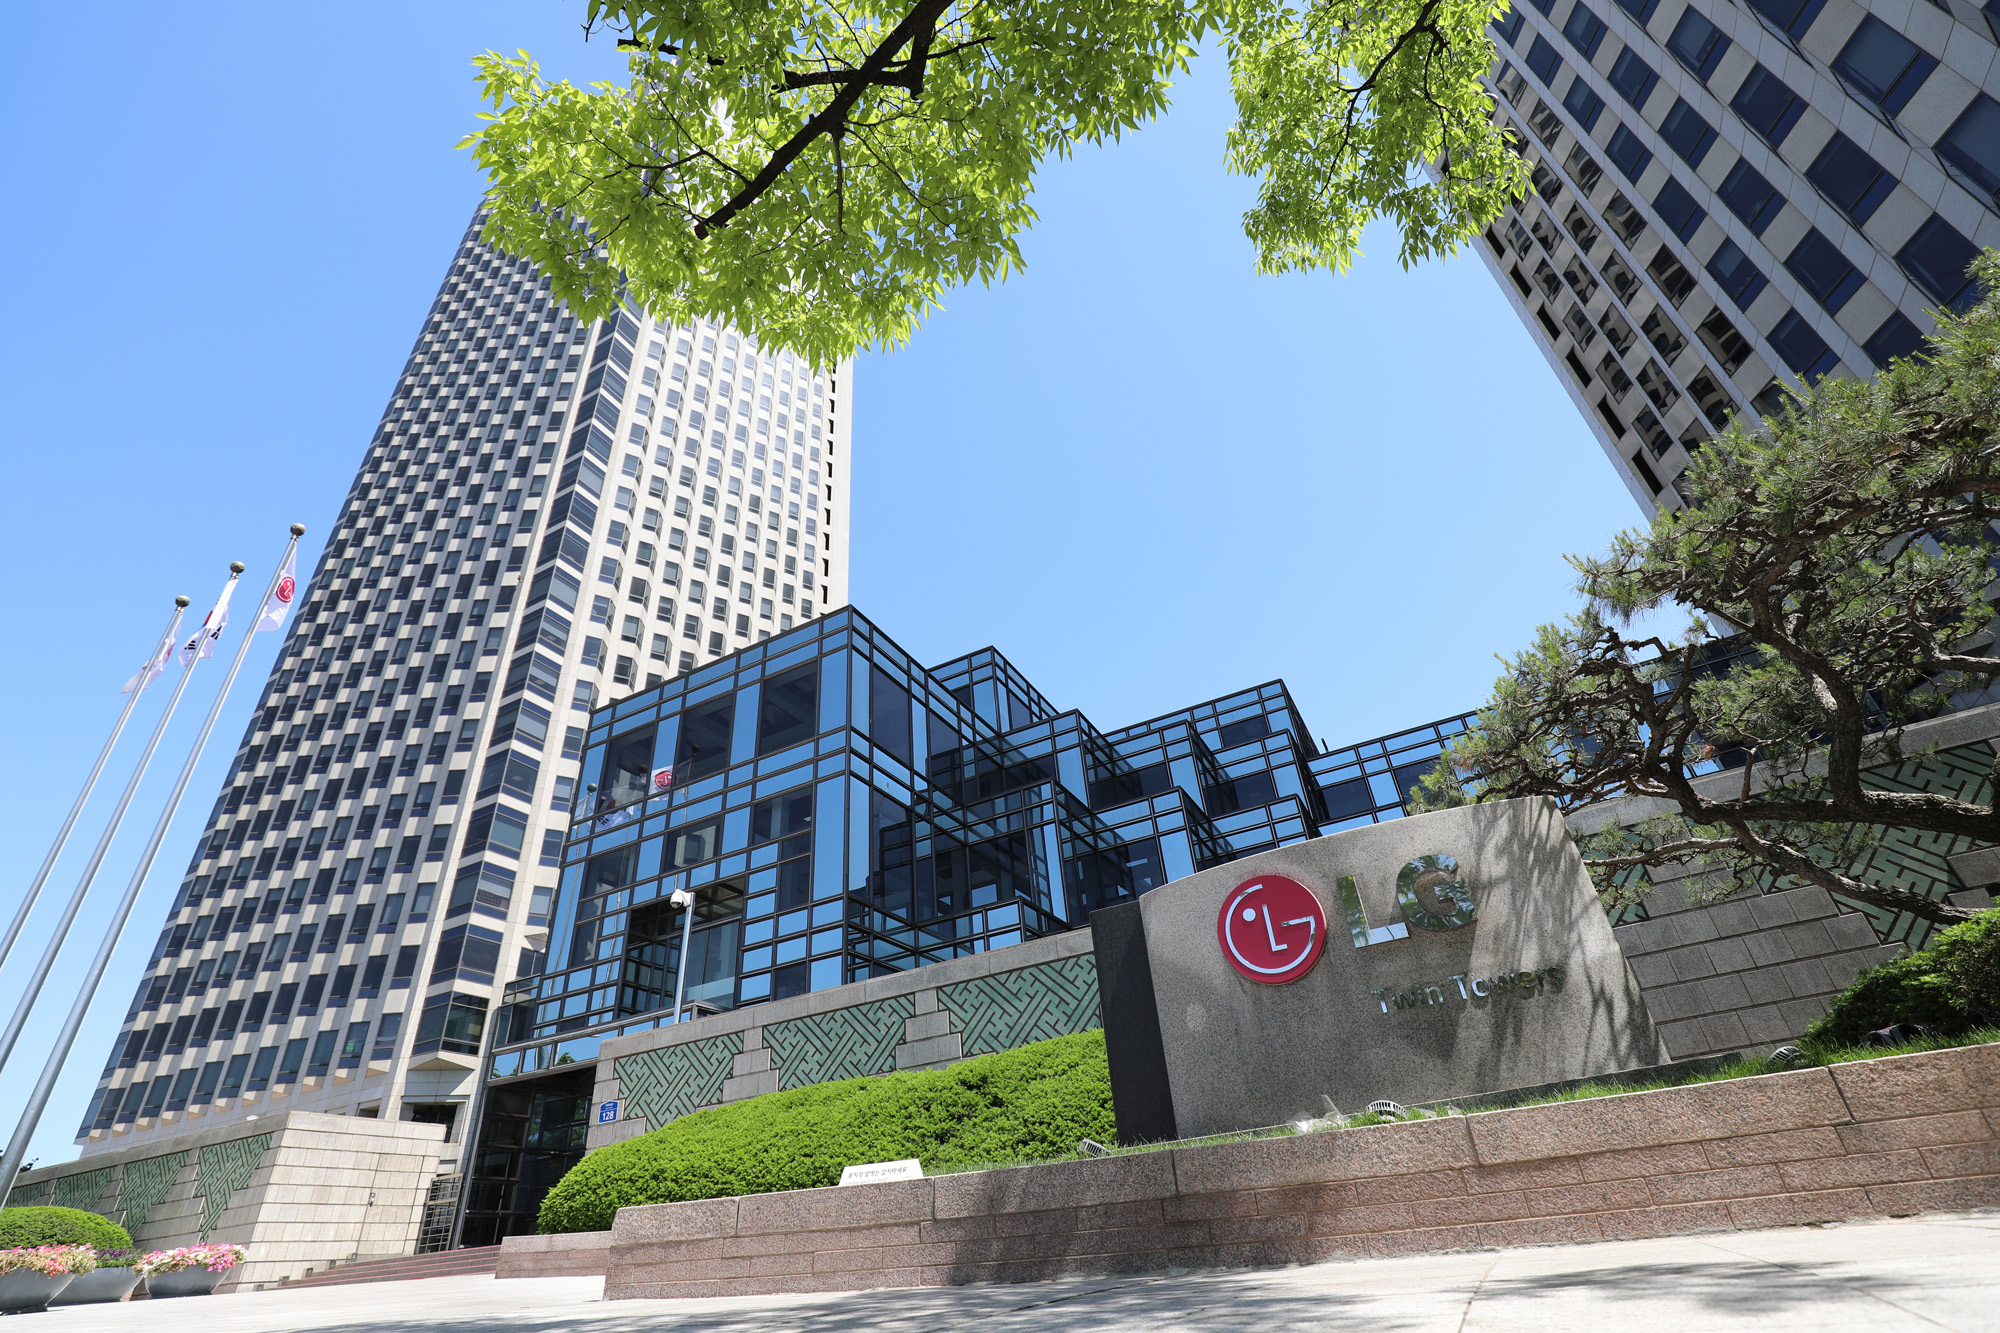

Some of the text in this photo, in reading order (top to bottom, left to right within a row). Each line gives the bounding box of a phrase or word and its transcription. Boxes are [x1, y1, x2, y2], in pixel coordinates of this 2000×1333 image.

[1336, 854, 1478, 949] LG
[1370, 967, 1565, 1014] Twin Towers
[602, 1111, 614, 1121] 128
